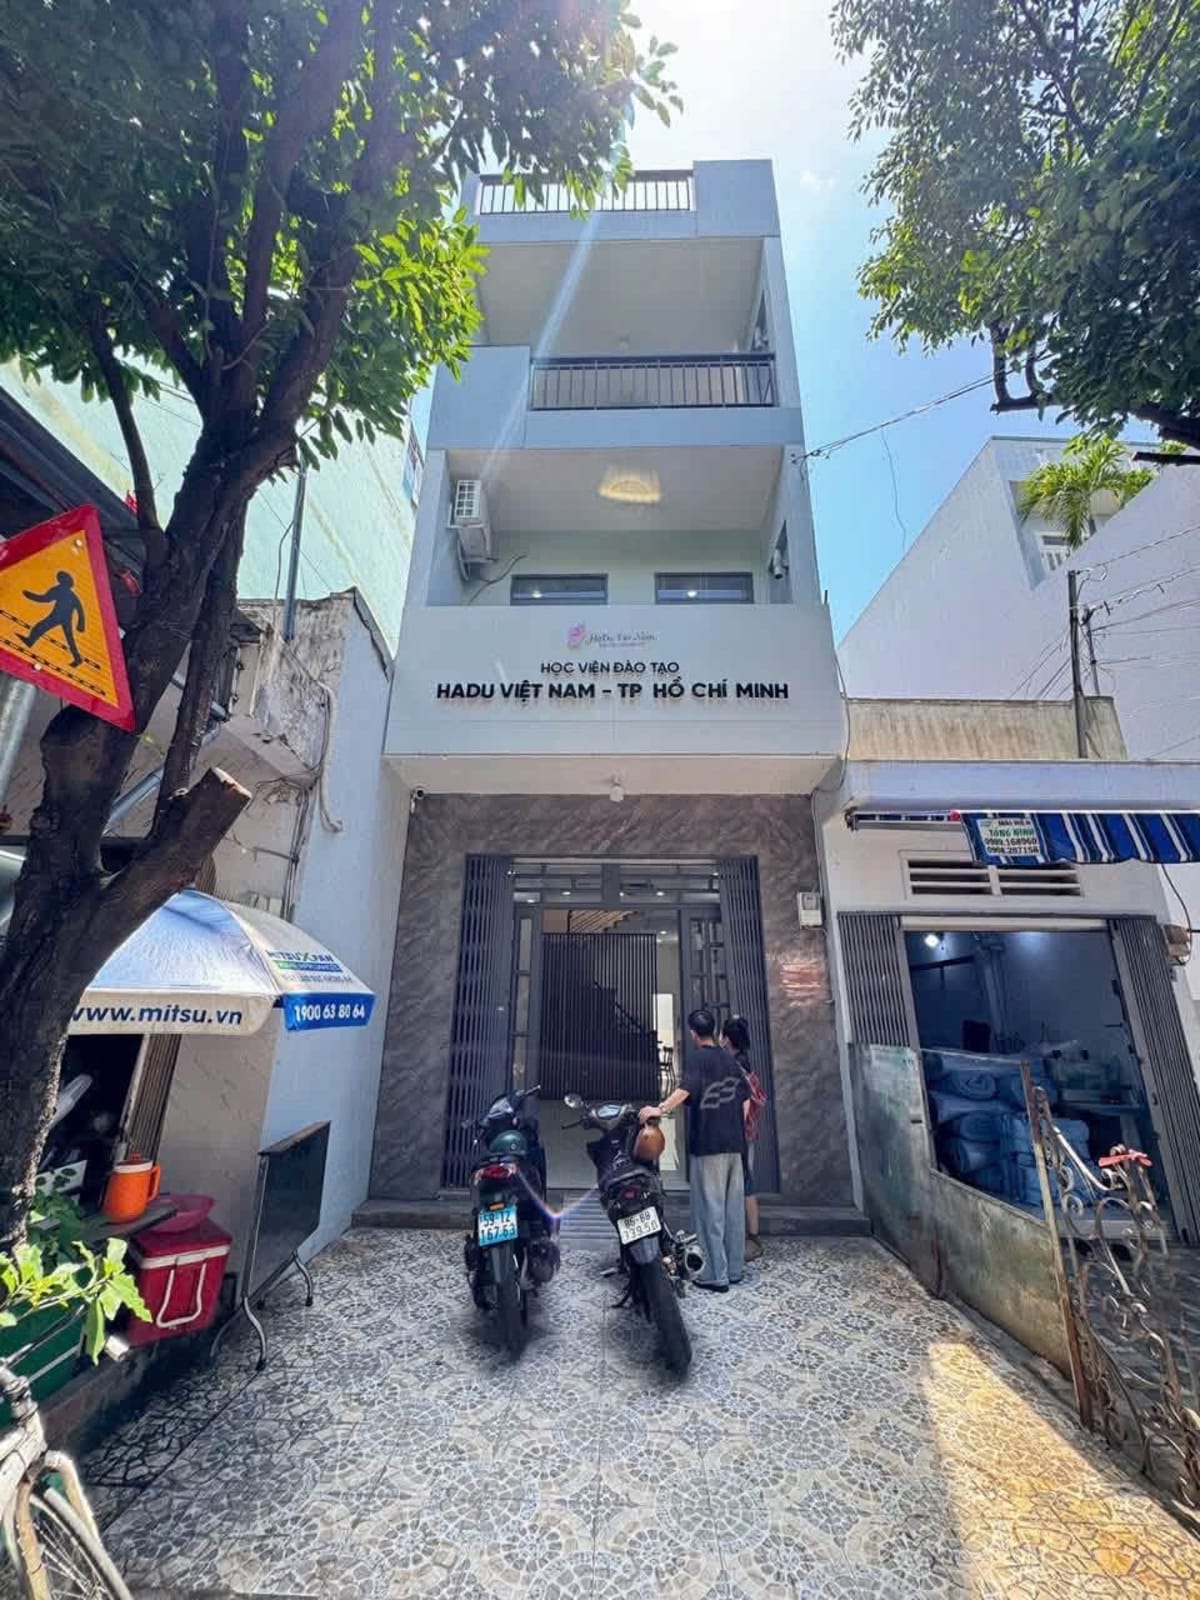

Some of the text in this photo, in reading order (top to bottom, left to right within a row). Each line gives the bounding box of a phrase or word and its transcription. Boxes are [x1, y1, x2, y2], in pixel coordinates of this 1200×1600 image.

[540, 660, 680, 676] HỌC VIỆN ĐÀO TẠO
[437, 683, 495, 699] HADU
[500, 680, 543, 702] VIỆT
[548, 683, 596, 699] NAM
[617, 683, 643, 699] TP
[653, 676, 685, 699] HỒ
[691, 678, 728, 699] CHÍ
[735, 683, 789, 700] MINH
[294, 1003, 365, 1022] 1900 63 80 64
